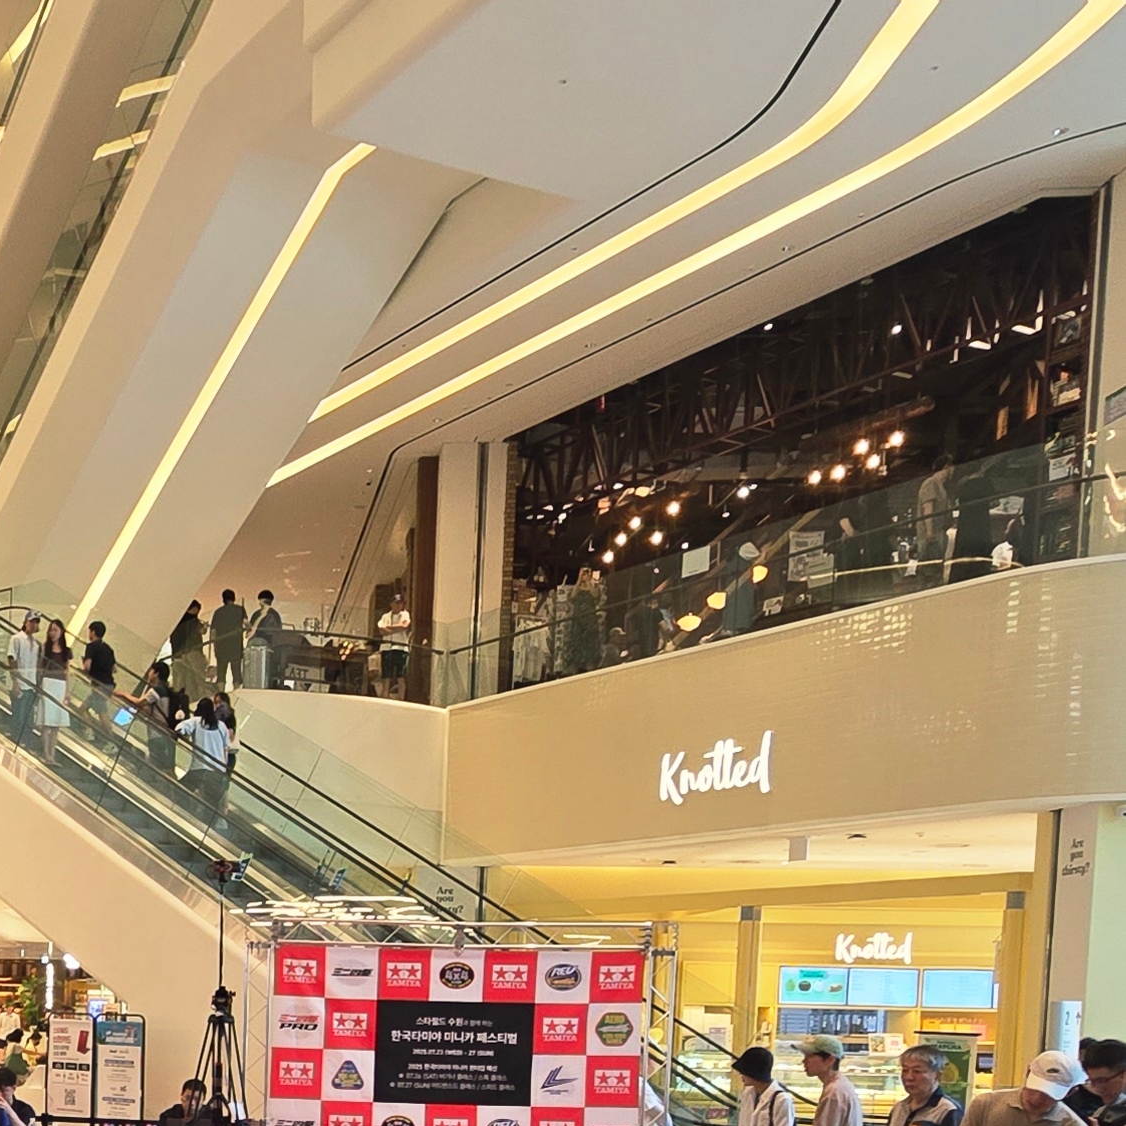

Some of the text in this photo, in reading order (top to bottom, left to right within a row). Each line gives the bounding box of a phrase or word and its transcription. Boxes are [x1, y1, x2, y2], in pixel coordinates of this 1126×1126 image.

[659, 729, 774, 805] Knotted
[436, 886, 454, 895] Are
[835, 931, 913, 965] Knotted
[283, 976, 317, 984] TAMIYA
[386, 979, 421, 987] TAMIYA
[491, 981, 527, 989] TAMIYA
[599, 982, 635, 990] TAMIYA
[279, 1023, 318, 1031] PRO
[391, 1030, 517, 1045] 한국타미야 미니카 페스티벌
[542, 1034, 577, 1042] TAMIYA
[595, 1087, 630, 1095] TAMIYA
